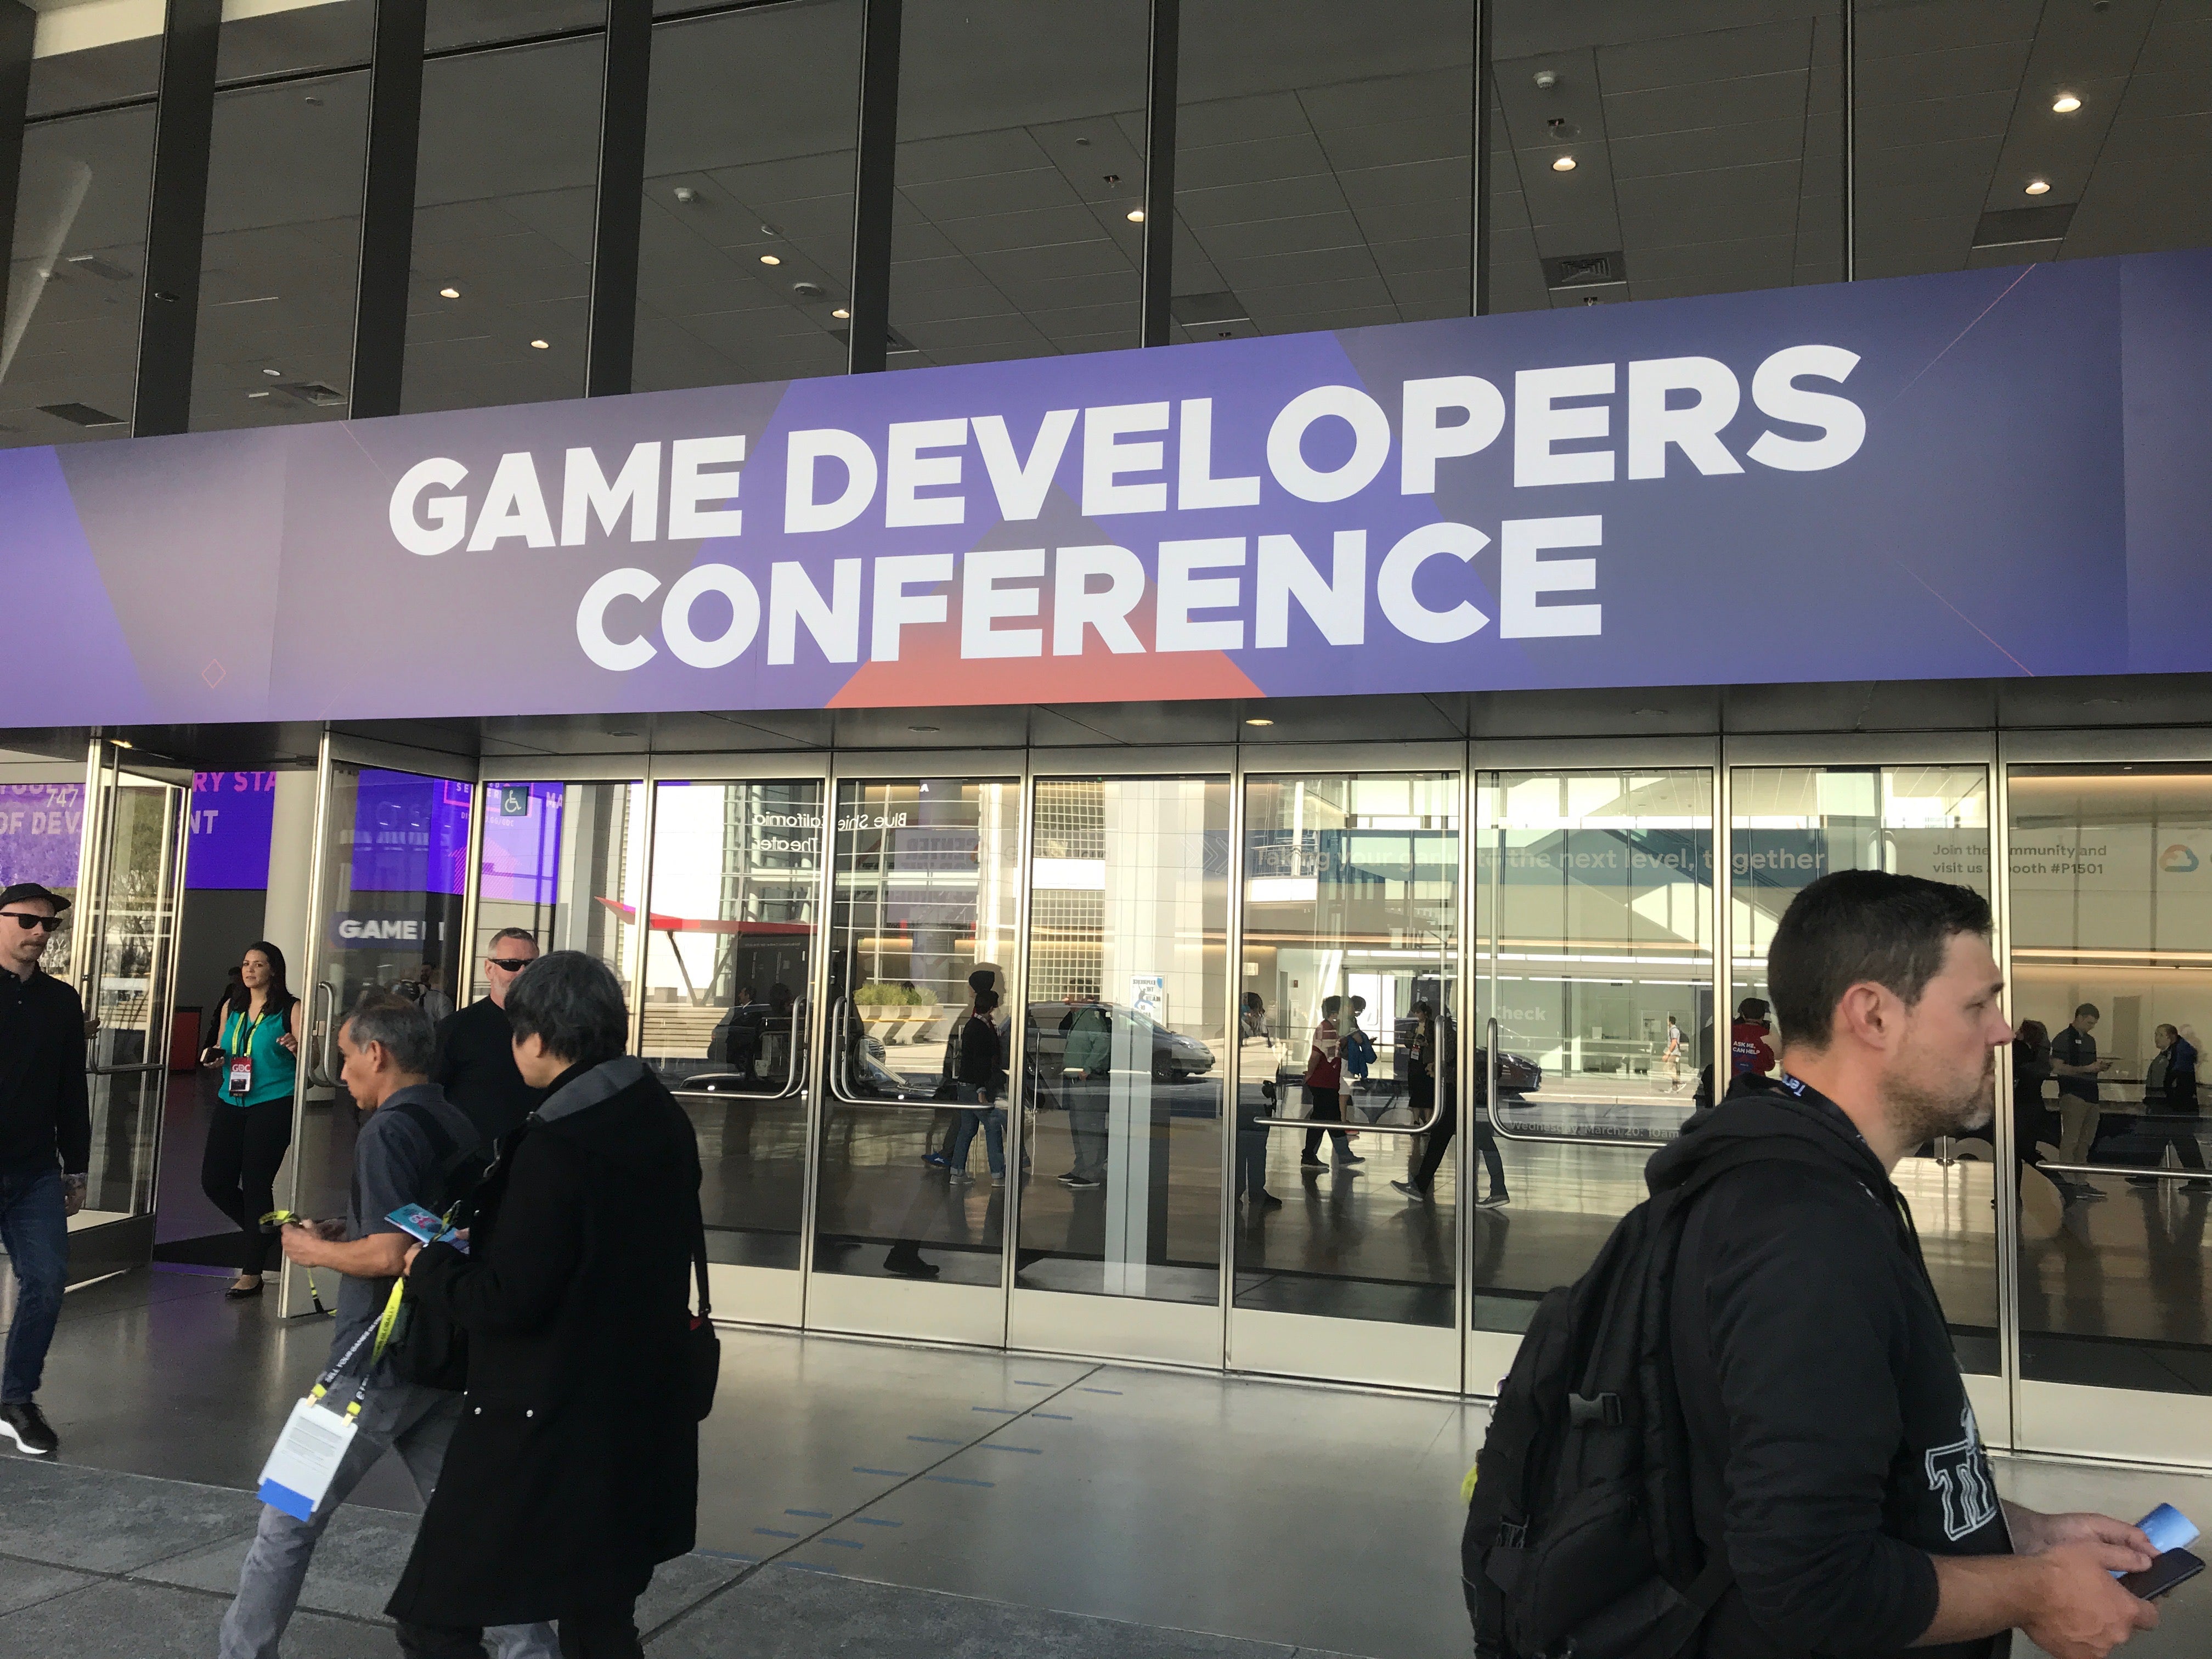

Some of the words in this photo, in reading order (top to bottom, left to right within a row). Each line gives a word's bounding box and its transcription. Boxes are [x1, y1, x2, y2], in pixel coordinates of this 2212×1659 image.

[389, 435, 746, 556] GAME
[784, 345, 1866, 534] DEVELOPERS
[576, 515, 1602, 672] CONFERENCE
[47, 788, 79, 808] 747
[1933, 844, 1962, 856] Join
[2079, 845, 2107, 856] and
[1338, 850, 1390, 871] your
[1510, 848, 1550, 868] the
[1560, 849, 1617, 868] next
[1624, 848, 1695, 871] level,
[1702, 848, 1825, 874] tgether
[1933, 862, 1963, 873] visit
[1967, 865, 1983, 873] us
[2010, 863, 2046, 874] ooth
[2051, 863, 2103, 874] #P1501
[338, 919, 417, 940] GAME
[232, 1064, 251, 1072] GDC
[1584, 1123, 1621, 1137] March
